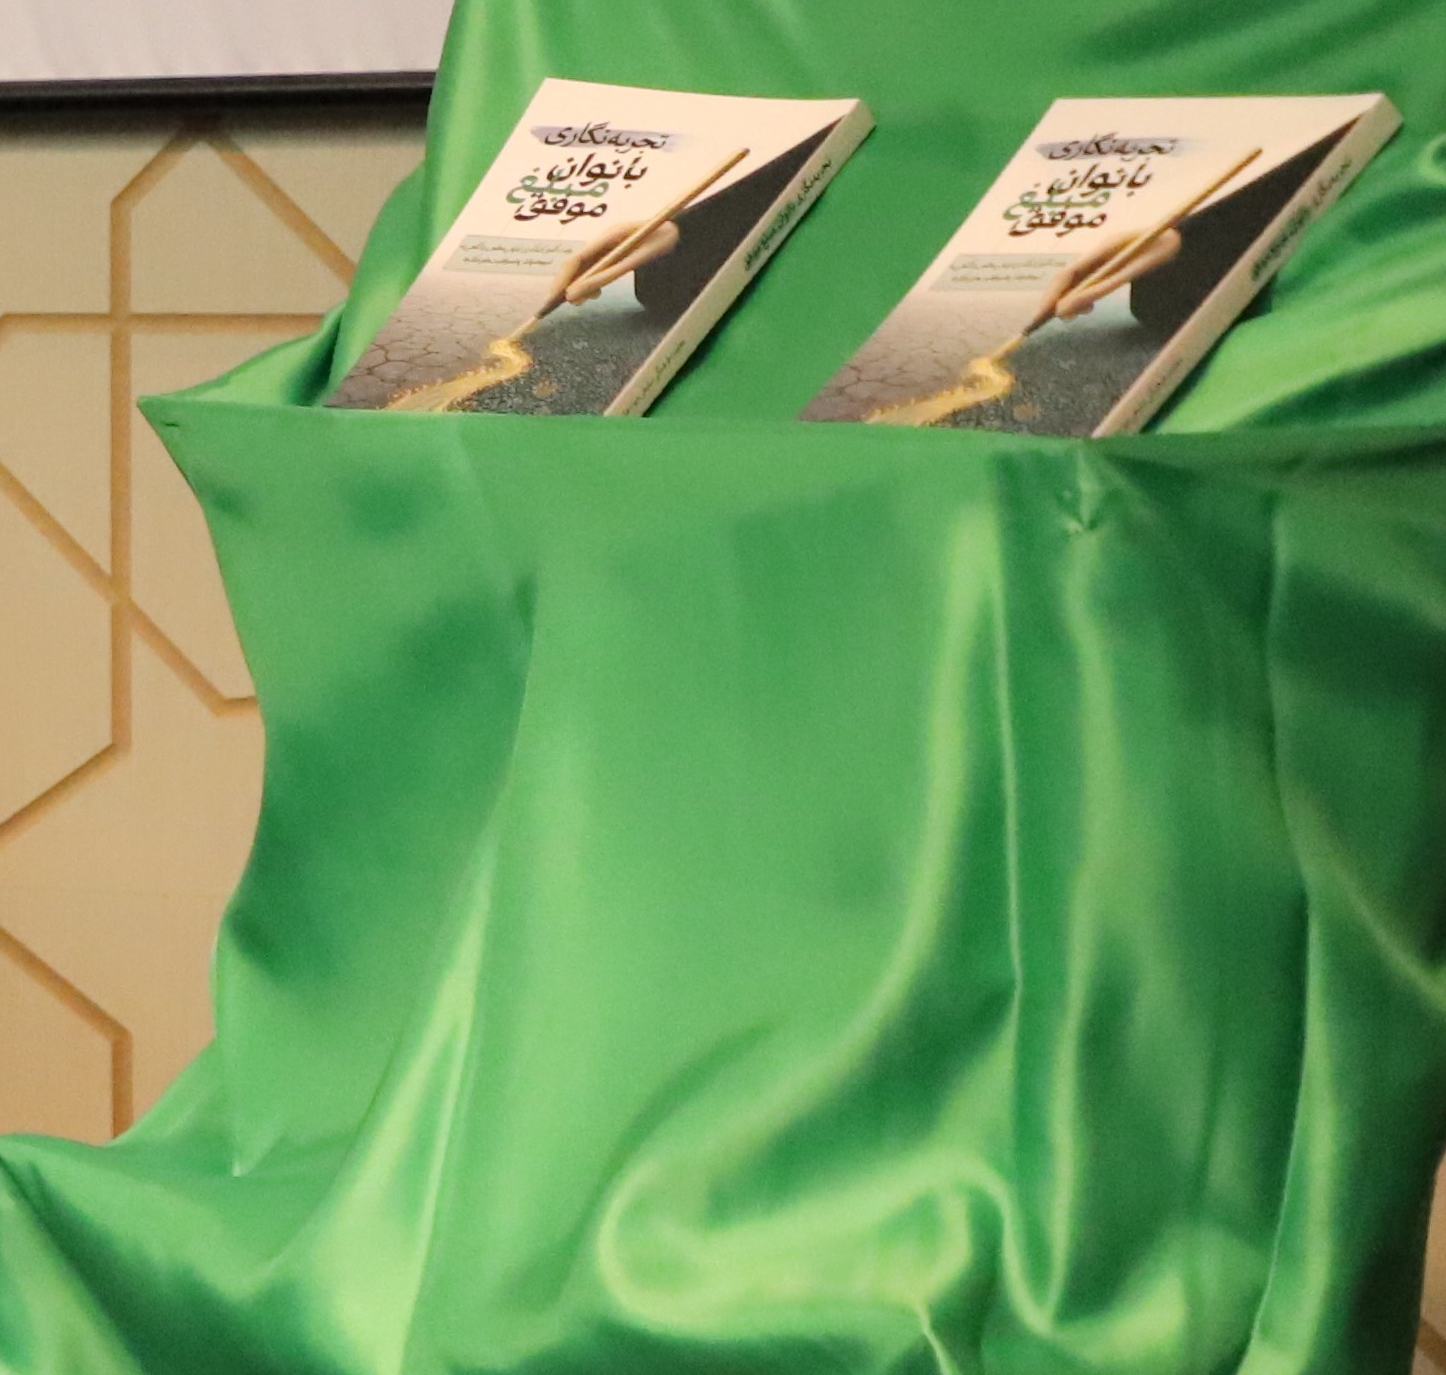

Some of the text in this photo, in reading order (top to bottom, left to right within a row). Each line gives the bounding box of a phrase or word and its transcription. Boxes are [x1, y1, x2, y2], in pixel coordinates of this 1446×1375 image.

[505, 166, 610, 204] مبلغ
[546, 151, 649, 189] بانوان
[1047, 158, 1153, 197] بانوان
[513, 192, 608, 225] موفق
[1008, 206, 1107, 238] موفق
